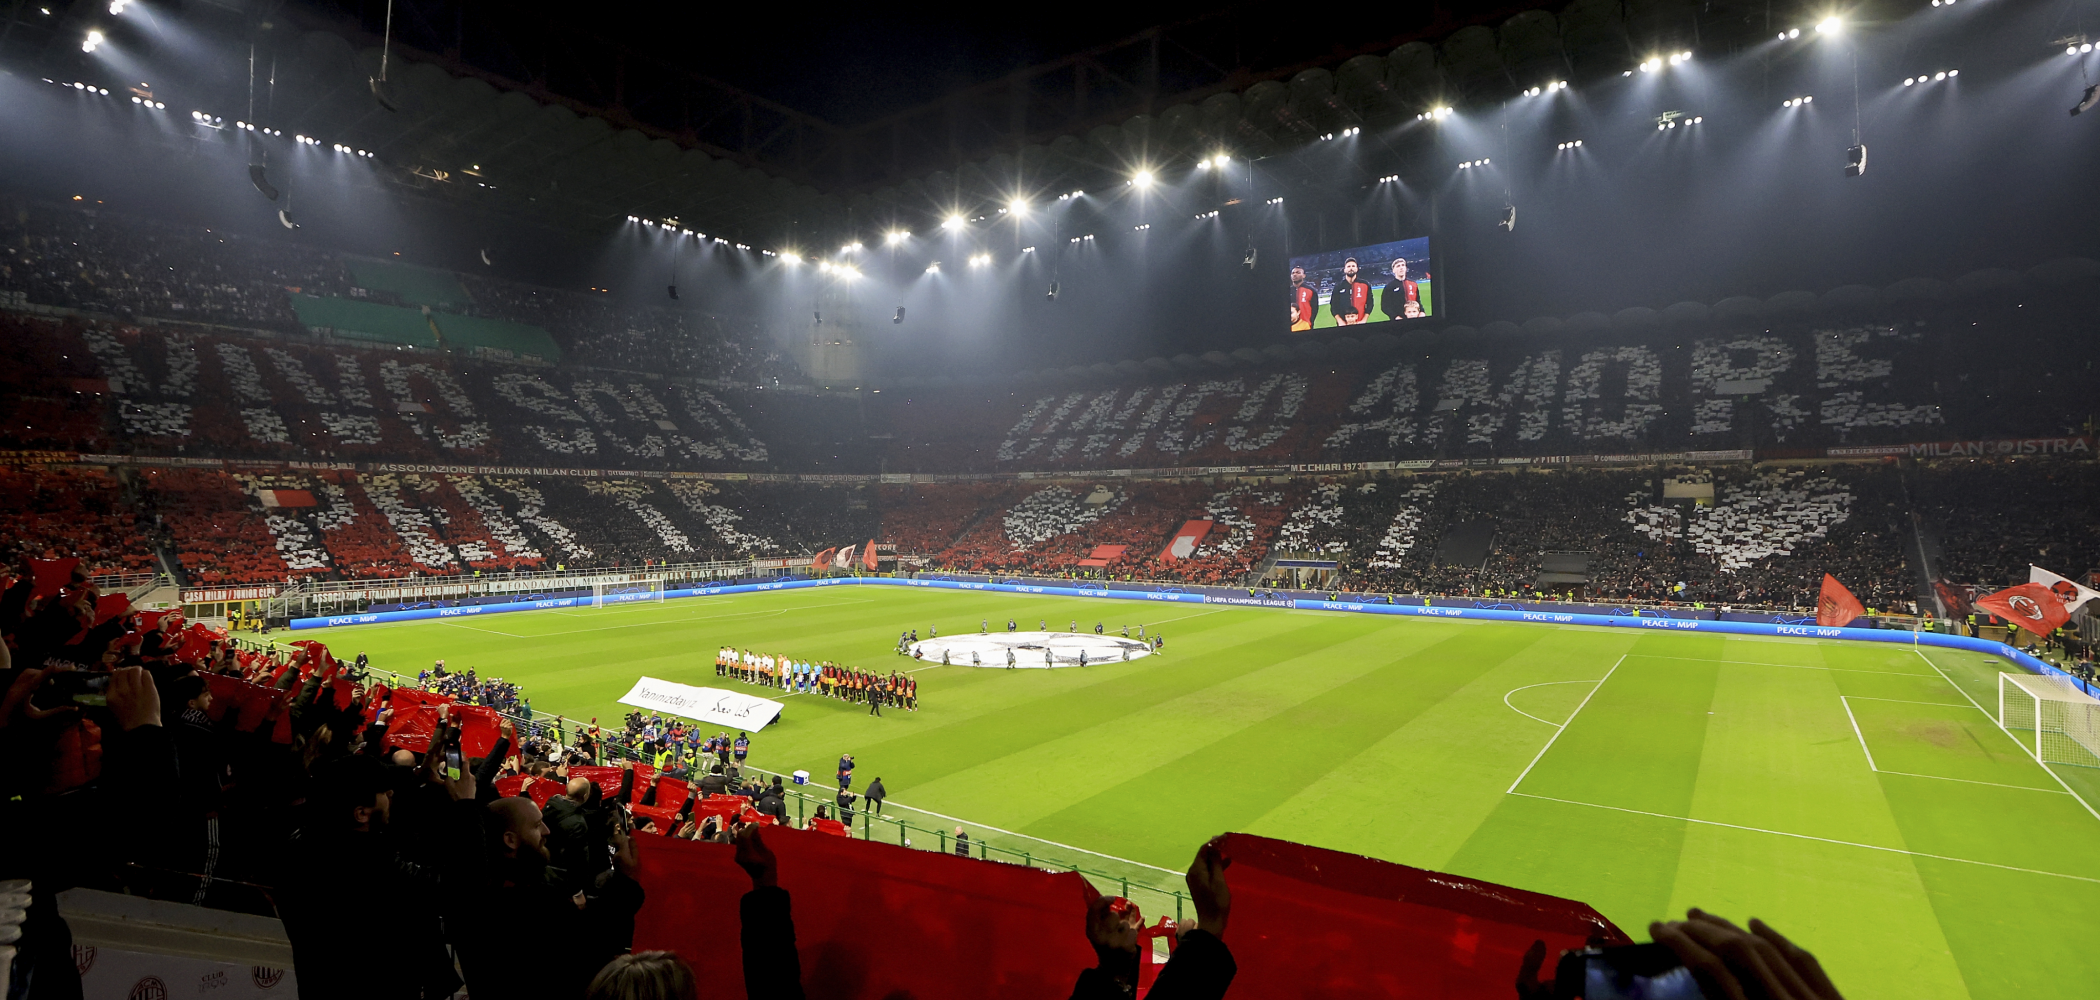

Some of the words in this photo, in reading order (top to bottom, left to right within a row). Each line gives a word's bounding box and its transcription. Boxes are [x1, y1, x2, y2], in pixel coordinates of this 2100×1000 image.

[1323, 321, 1946, 450] AMORE
[1910, 442, 1984, 458] MILAN
[2018, 437, 2090, 455] ISTRA
[1600, 454, 1649, 462] COMMERCIALISTI
[289, 461, 310, 469] MILAN
[1307, 463, 1341, 472] CHIARI
[1342, 463, 1362, 471] 1973
[379, 464, 476, 473] ASSOCIAZIONE
[479, 466, 531, 475] ITALIANA
[534, 468, 567, 476] MILAN
[569, 469, 598, 477] CLUB
[646, 571, 685, 580] FAMILY
[691, 570, 712, 578] DAY
[508, 578, 577, 591] FONDAZIONE
[583, 576, 615, 586] MILAN
[184, 592, 203, 603] CASA
[205, 590, 227, 601] MILAN
[233, 588, 258, 599] JUNIOR
[259, 587, 276, 598] CLUB
[313, 591, 367, 603] ASSOCIAZIONE
[369, 589, 400, 600] ITALIANA
[401, 588, 423, 598] MILAN
[425, 587, 442, 597] CLUB
[443, 585, 467, 595] MONDO
[1228, 598, 1262, 606] CHAMPIONS
[329, 617, 353, 625] PEACE
[1641, 619, 1668, 627] PEACE
[1777, 626, 1807, 635] PEACE
[139, 980, 158, 990] ACM
